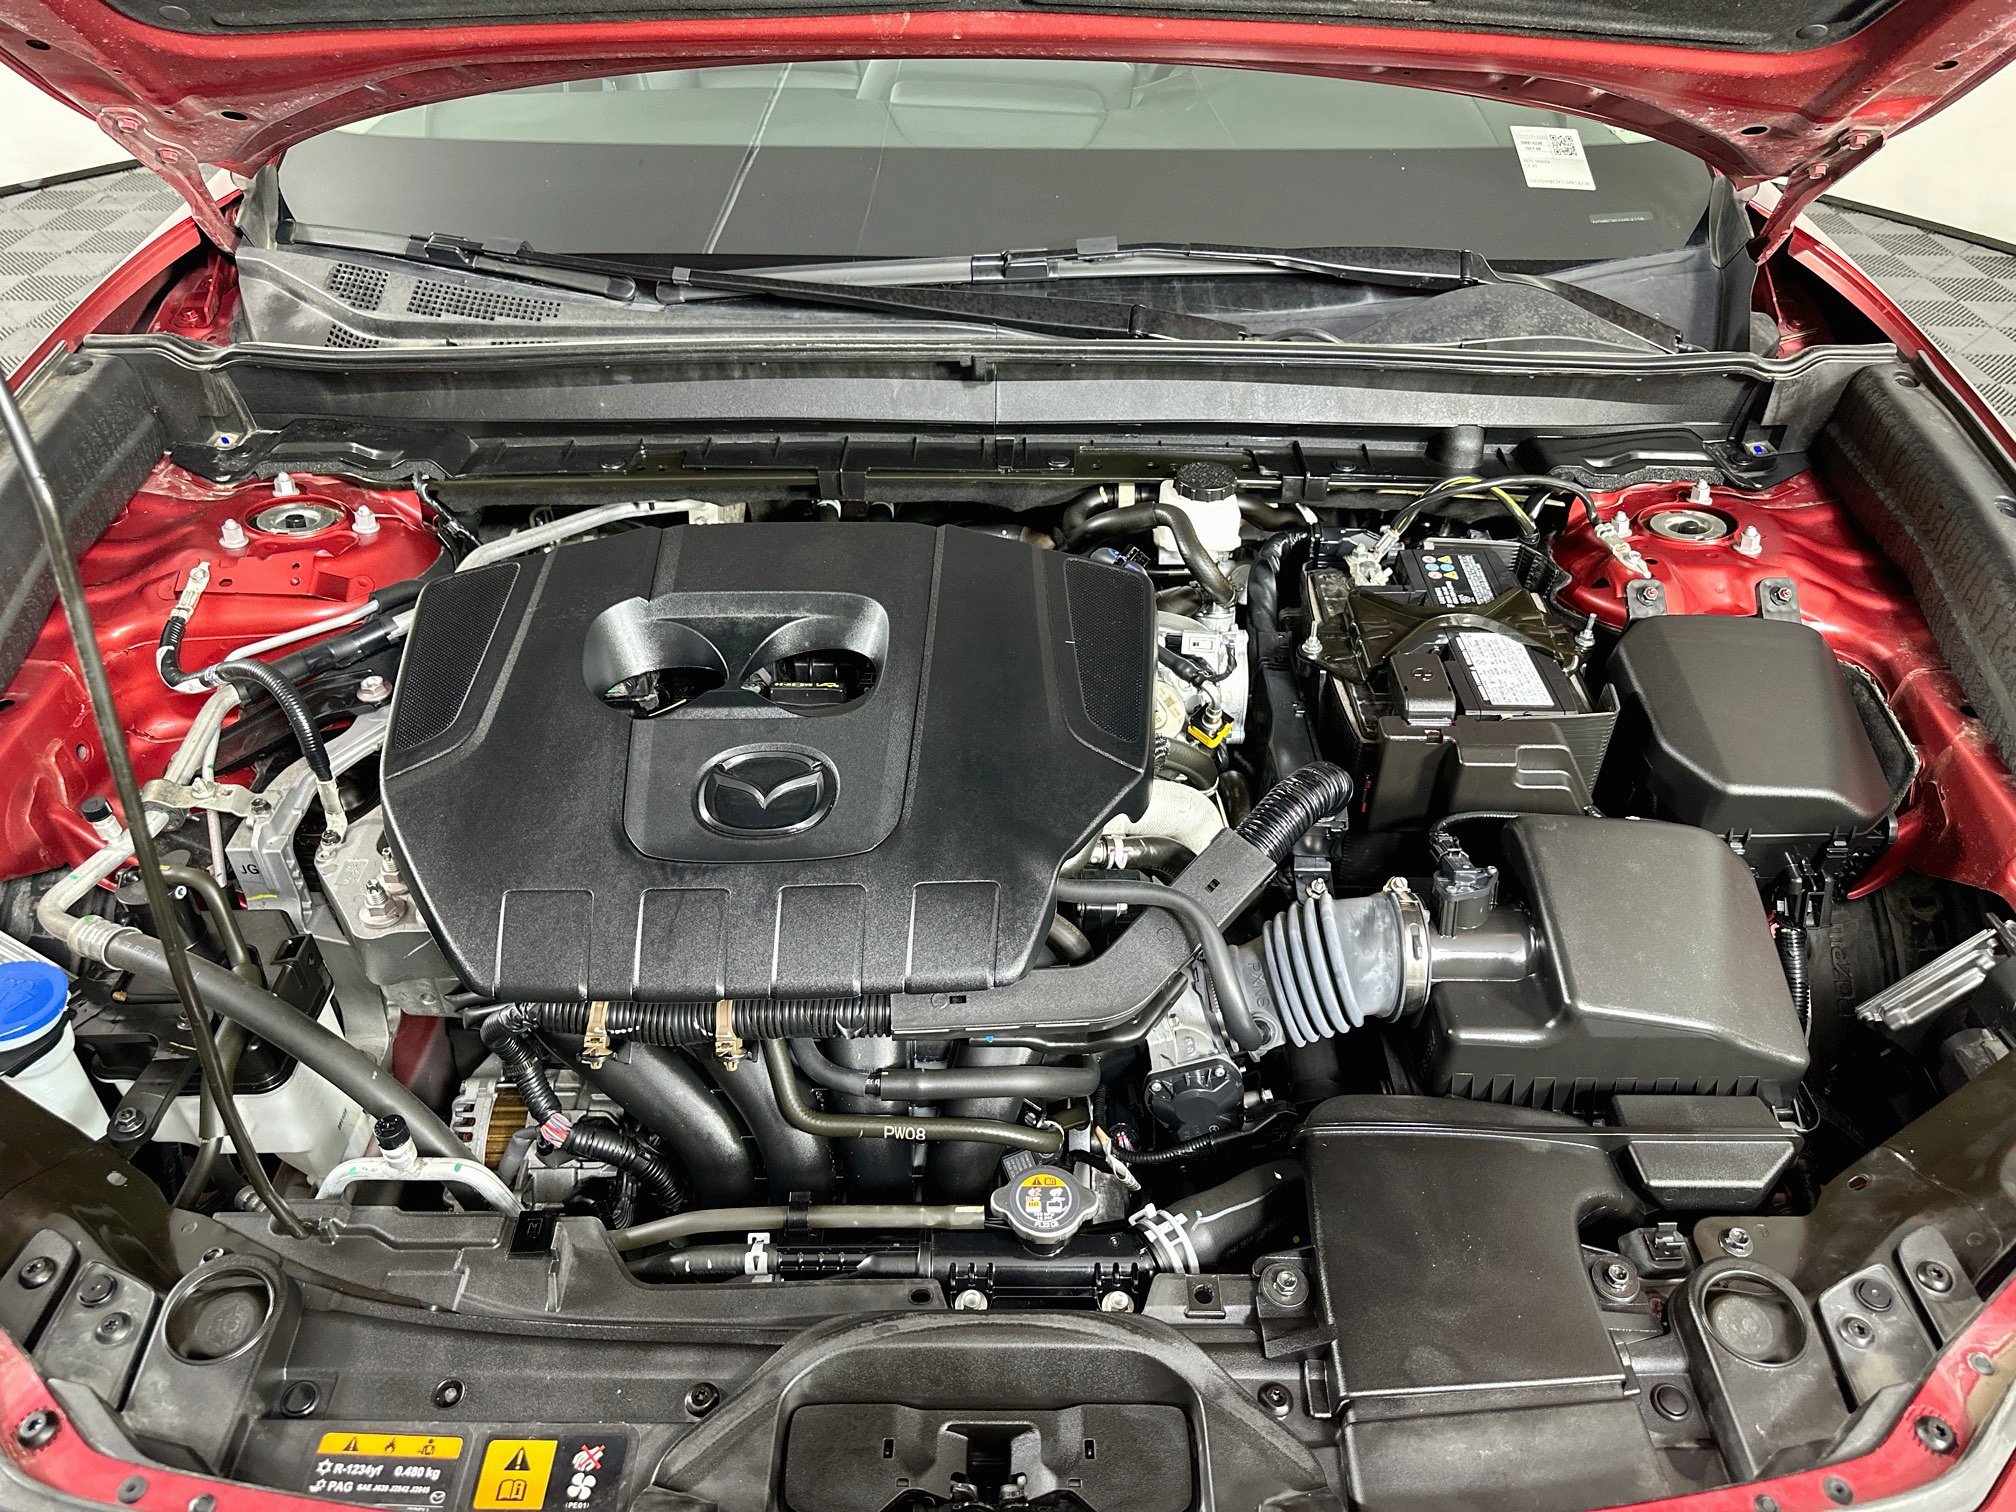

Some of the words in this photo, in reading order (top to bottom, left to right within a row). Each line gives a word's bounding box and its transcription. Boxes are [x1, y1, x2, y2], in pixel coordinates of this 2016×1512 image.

[241, 863, 260, 875] JG
[884, 1125, 926, 1141] PW08
[333, 1463, 384, 1479] R-1234yf
[393, 1465, 425, 1478] 0.480
[425, 1467, 441, 1481] kg
[327, 1480, 354, 1493] PAG
[356, 1483, 373, 1492] SAE
